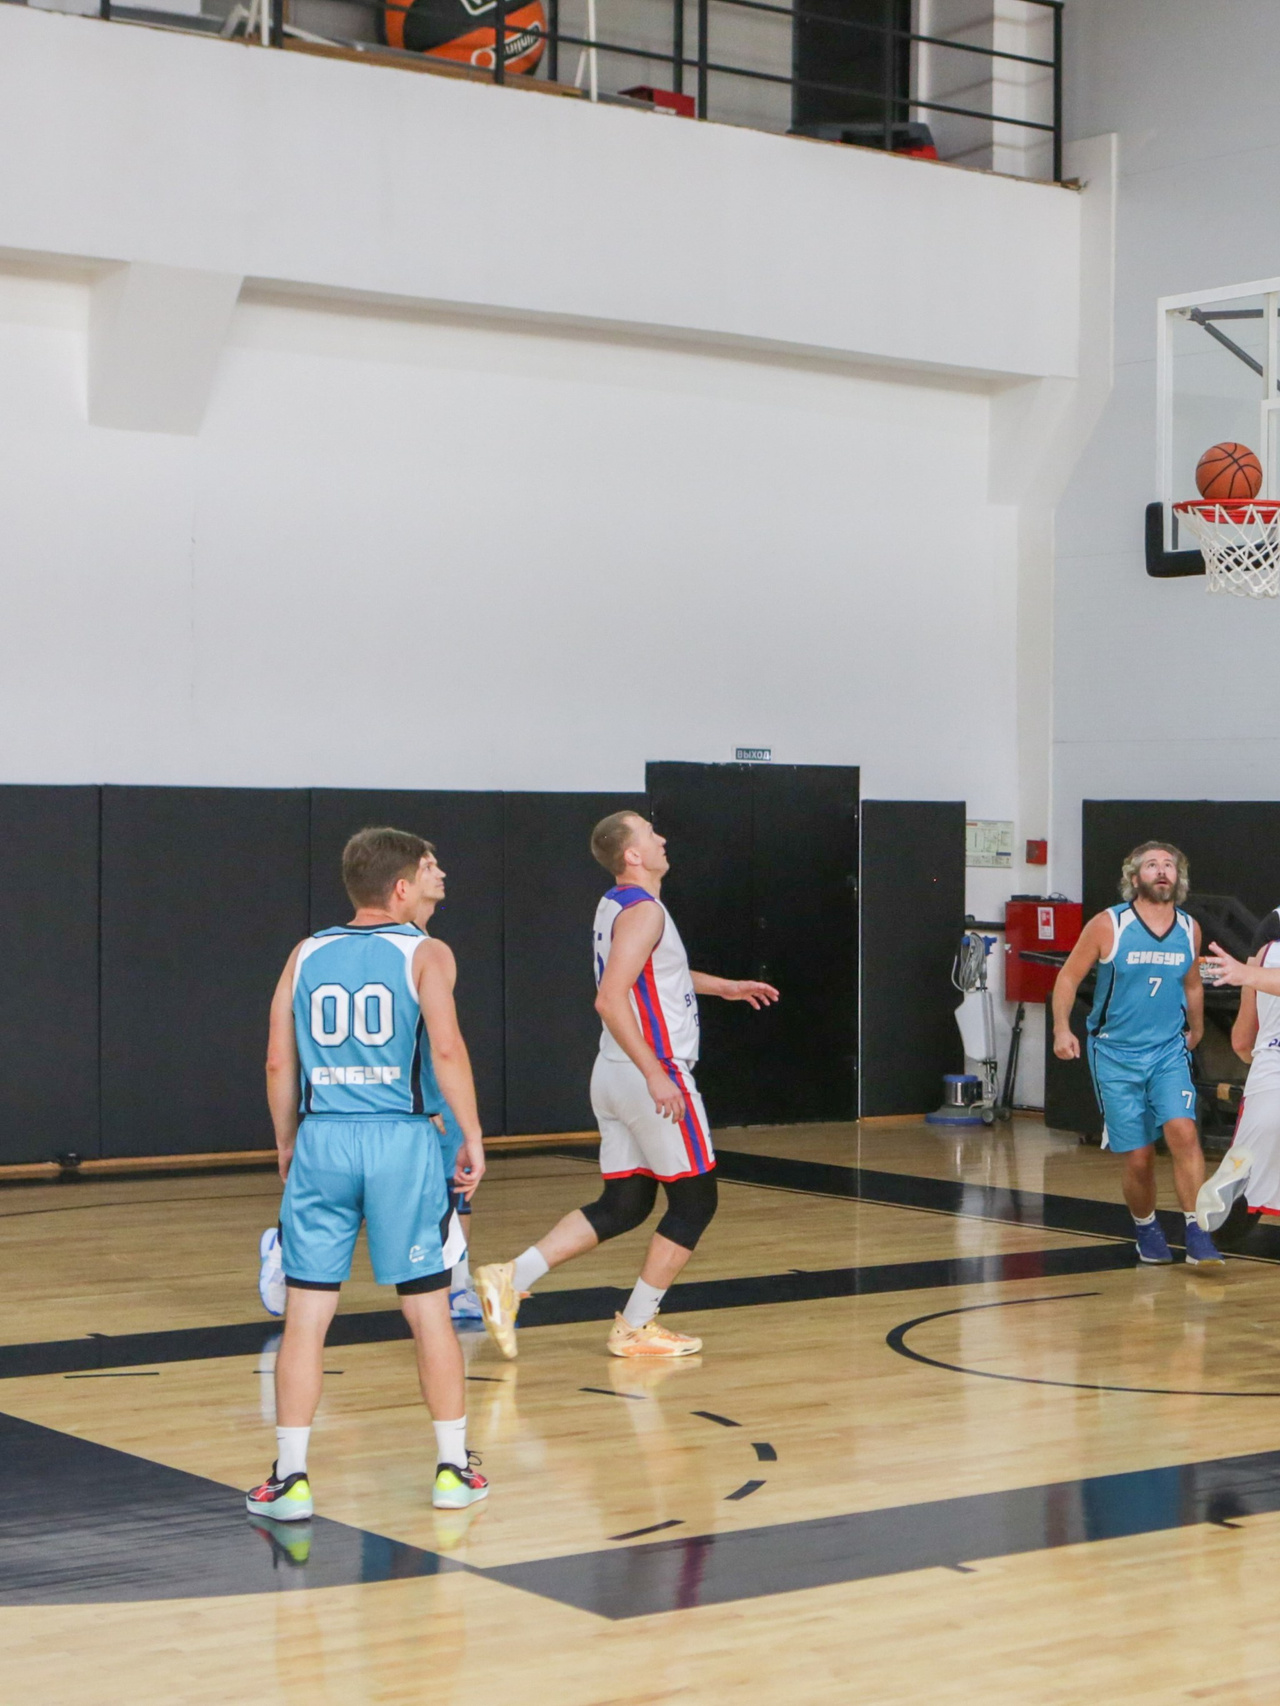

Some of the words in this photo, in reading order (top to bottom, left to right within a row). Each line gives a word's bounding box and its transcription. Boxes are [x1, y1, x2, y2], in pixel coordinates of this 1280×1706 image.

[737, 749, 770, 760] ВЫХОД
[1126, 951, 1185, 966] СИБУР
[1149, 977, 1162, 997] 7
[310, 982, 395, 1048] 00
[312, 1067, 400, 1085] СИБУР
[1181, 1090, 1192, 1109] 7
